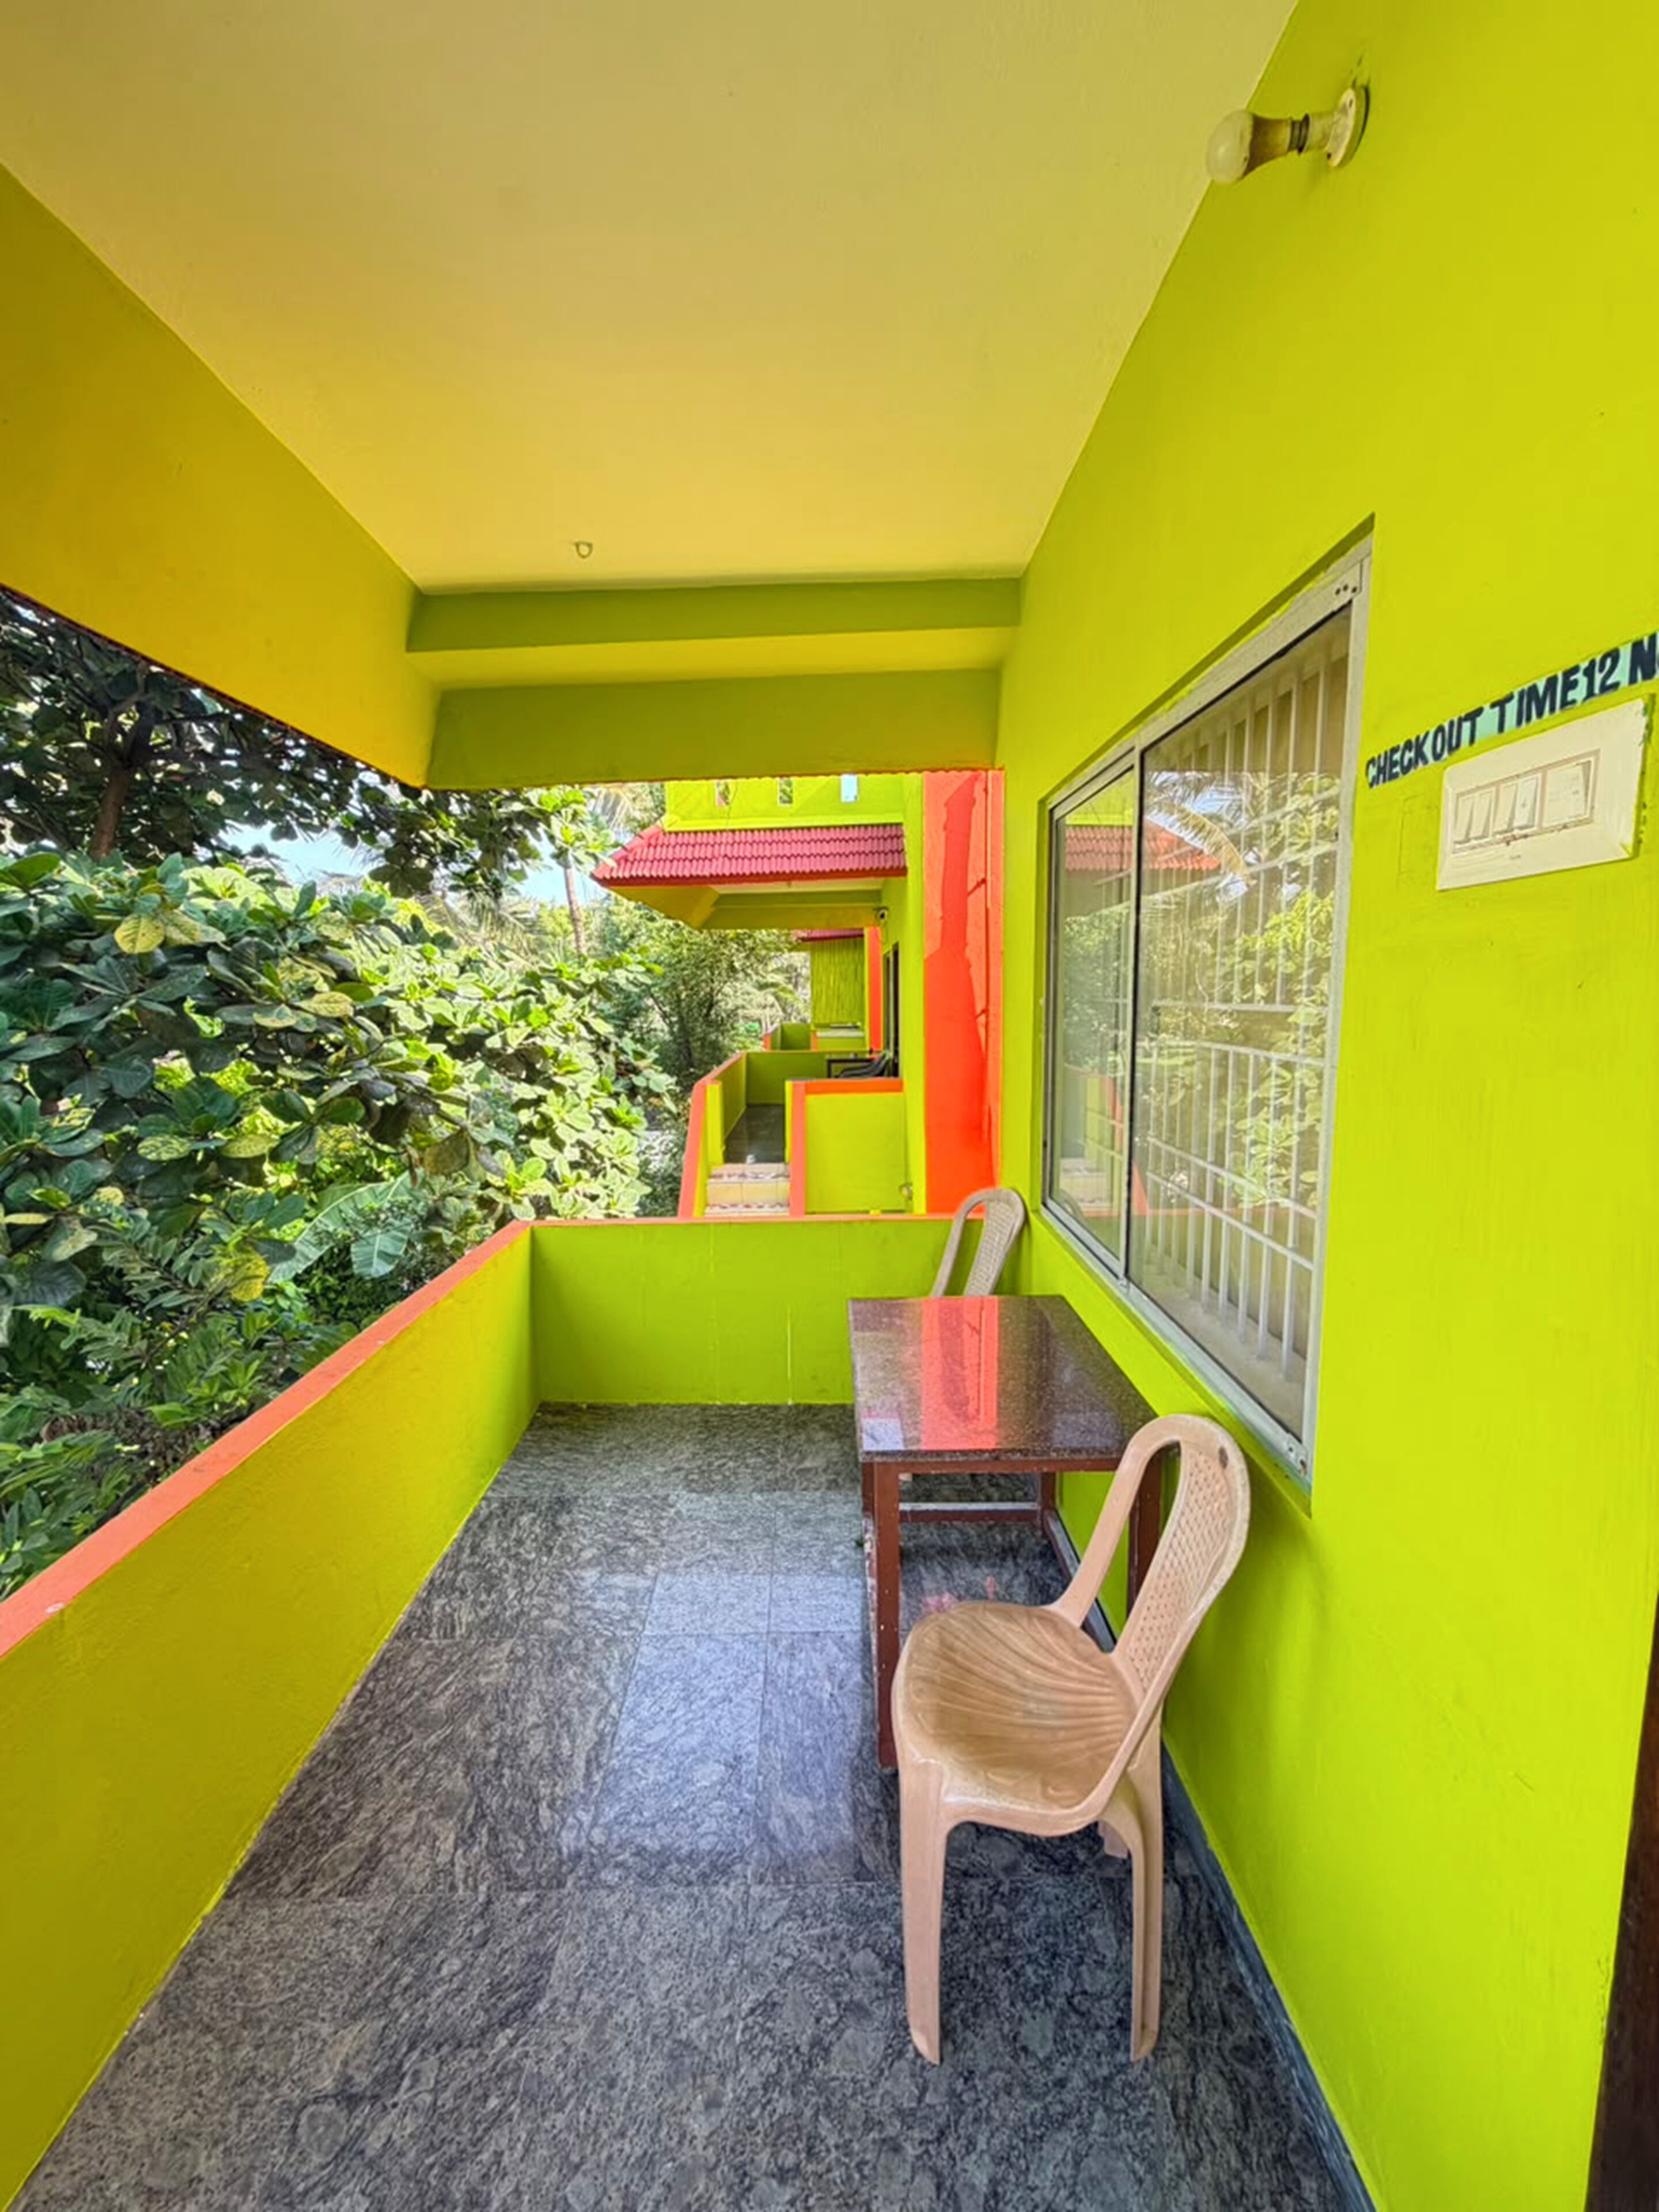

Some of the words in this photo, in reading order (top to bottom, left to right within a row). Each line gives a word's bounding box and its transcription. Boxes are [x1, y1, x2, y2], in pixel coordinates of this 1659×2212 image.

[1490, 664, 1580, 734] TIME
[1582, 647, 1620, 702] 12
[1628, 631, 1659, 686] N
